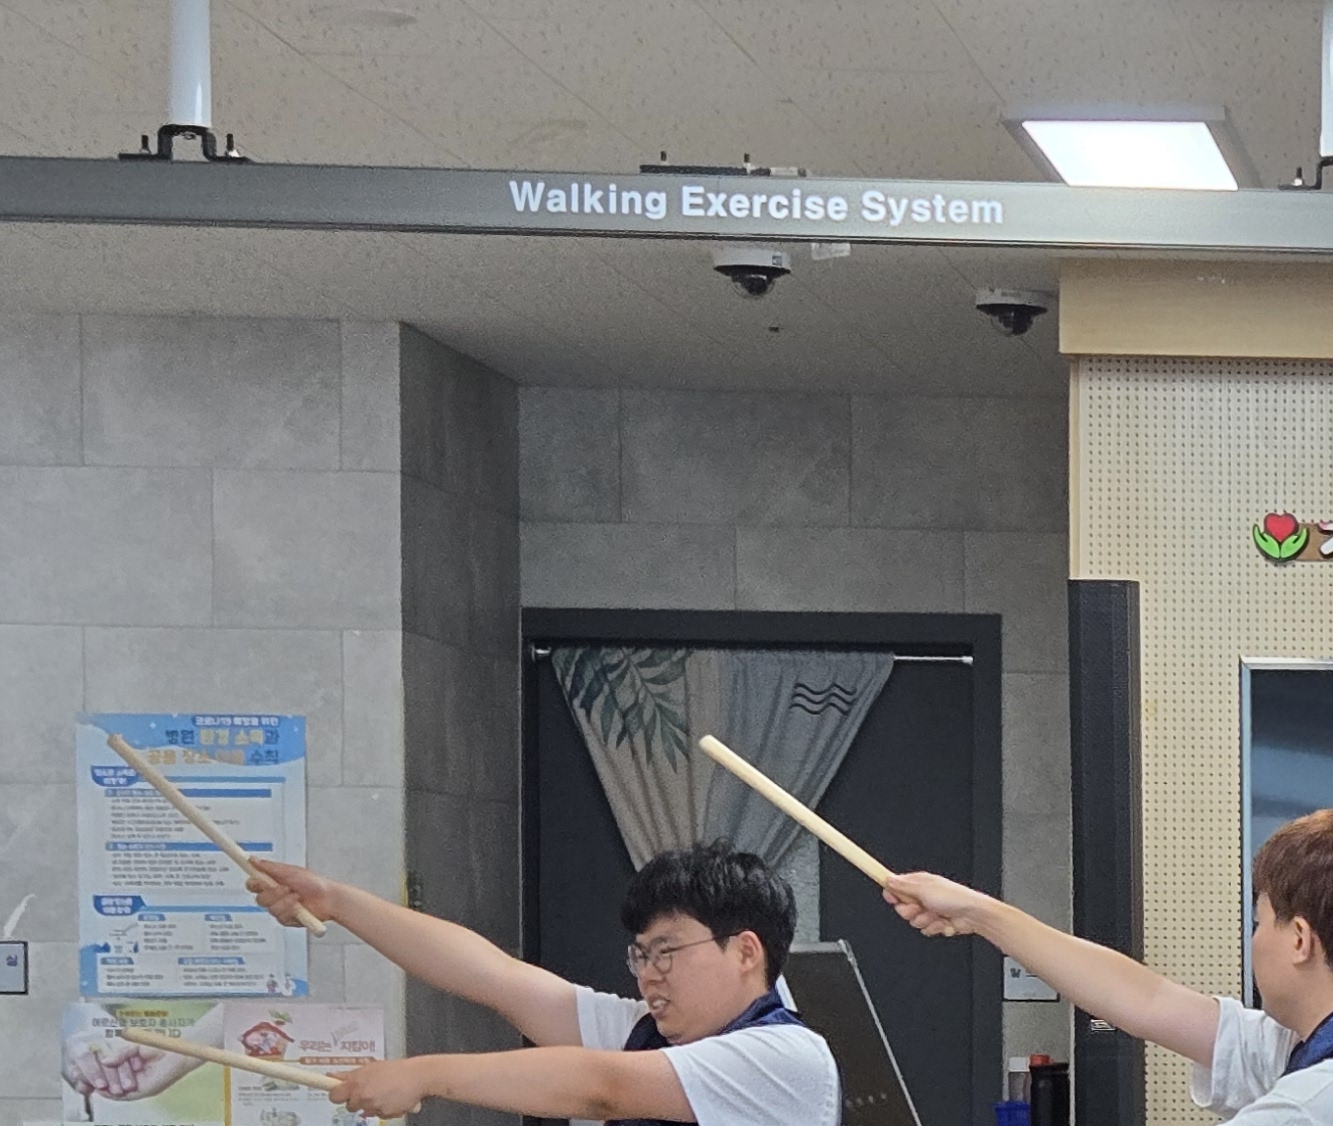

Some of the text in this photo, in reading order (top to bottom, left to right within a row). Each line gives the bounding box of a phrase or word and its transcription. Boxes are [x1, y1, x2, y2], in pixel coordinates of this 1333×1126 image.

[509, 181, 1004, 226] Walking Exercise System
